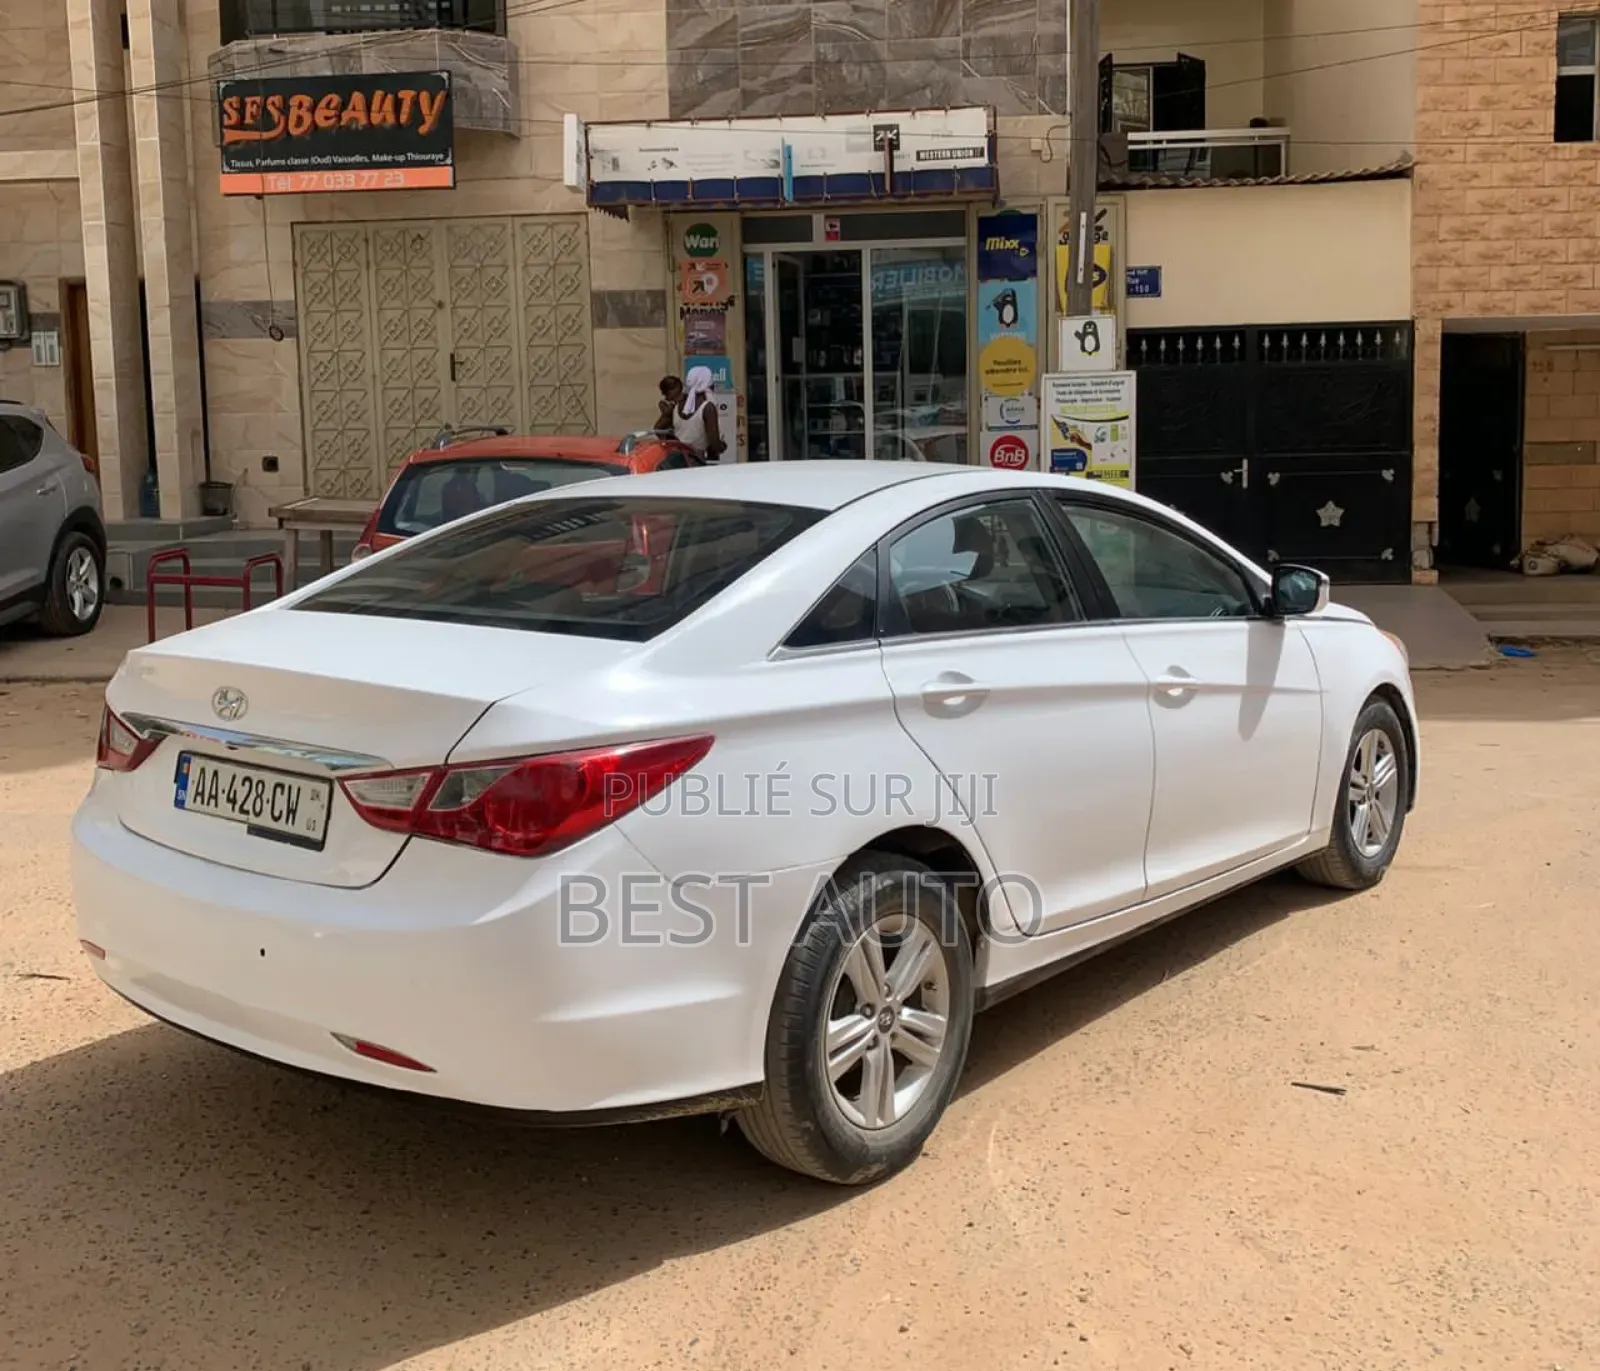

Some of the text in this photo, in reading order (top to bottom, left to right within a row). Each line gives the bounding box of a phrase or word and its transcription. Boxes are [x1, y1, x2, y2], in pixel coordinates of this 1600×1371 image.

[919, 150, 951, 160] WESTERN
[952, 149, 974, 159] UNION
[994, 449, 1026, 464] BnB
